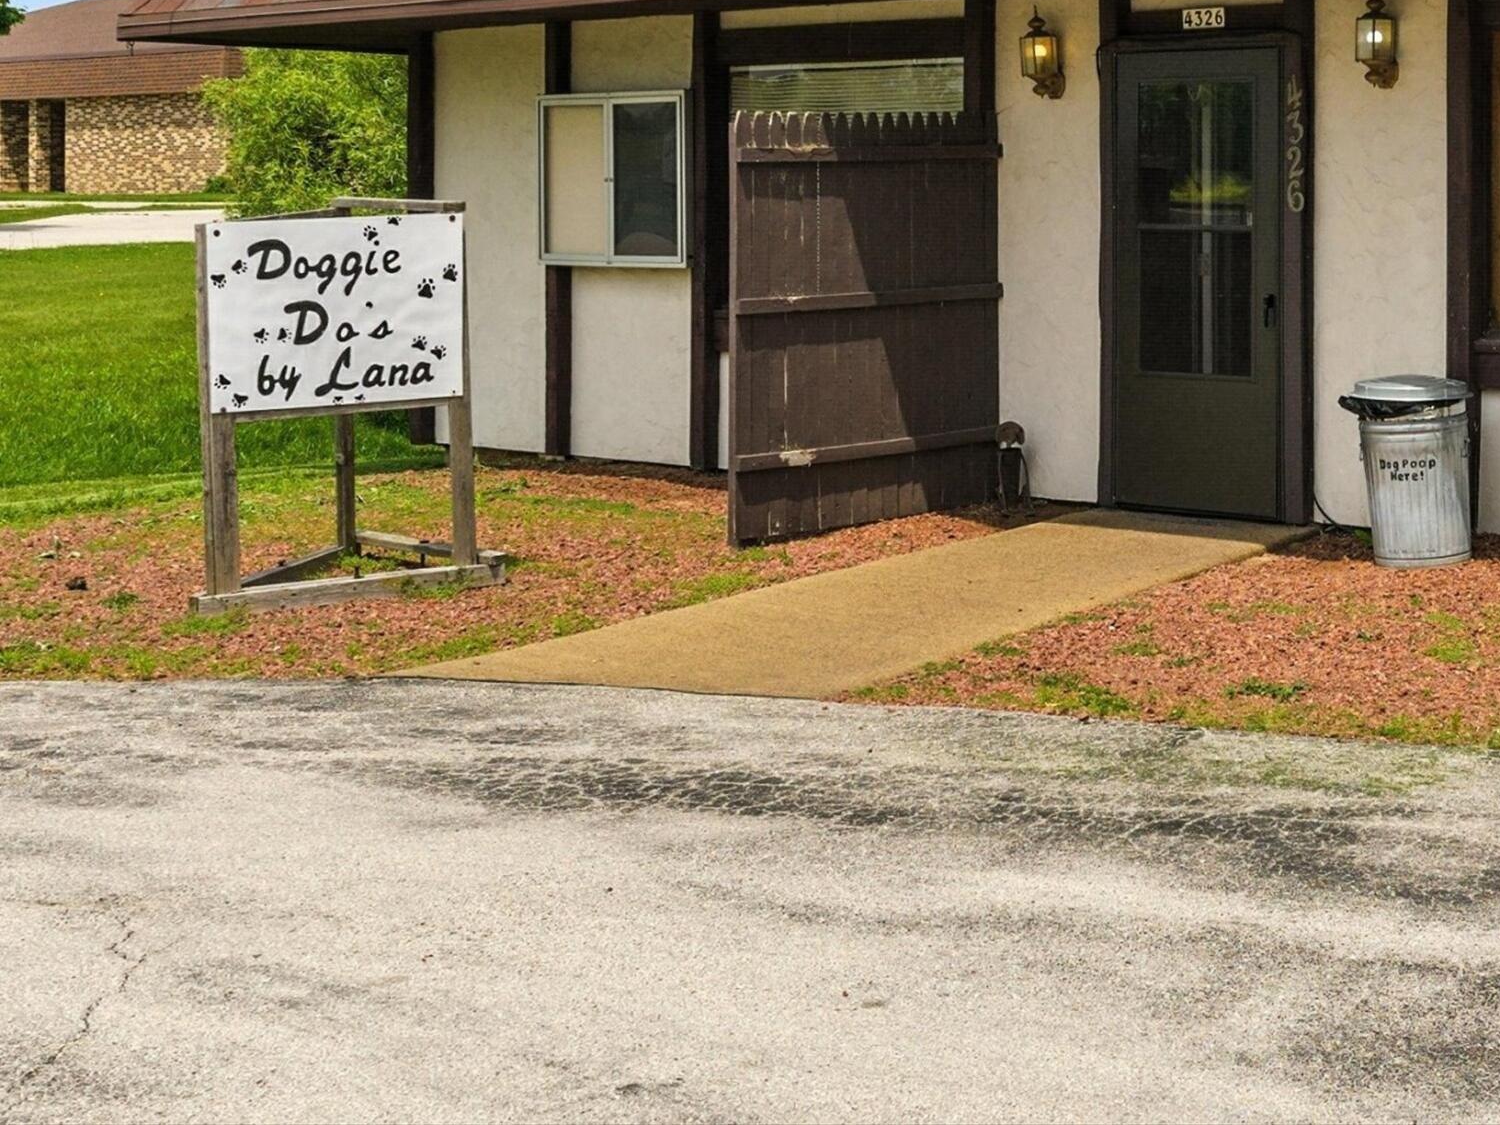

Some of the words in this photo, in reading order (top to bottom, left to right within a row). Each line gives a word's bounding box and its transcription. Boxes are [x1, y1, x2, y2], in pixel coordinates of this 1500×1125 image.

[1183, 9, 1224, 28] 4326
[1286, 74, 1305, 213] 4326
[247, 238, 402, 296] Doggie
[283, 300, 394, 345] Do's
[257, 355, 302, 401] by
[314, 346, 434, 397] Lana
[1379, 459, 1399, 472] Dog
[1402, 459, 1436, 470] Poop
[1390, 470, 1424, 481] Here!
